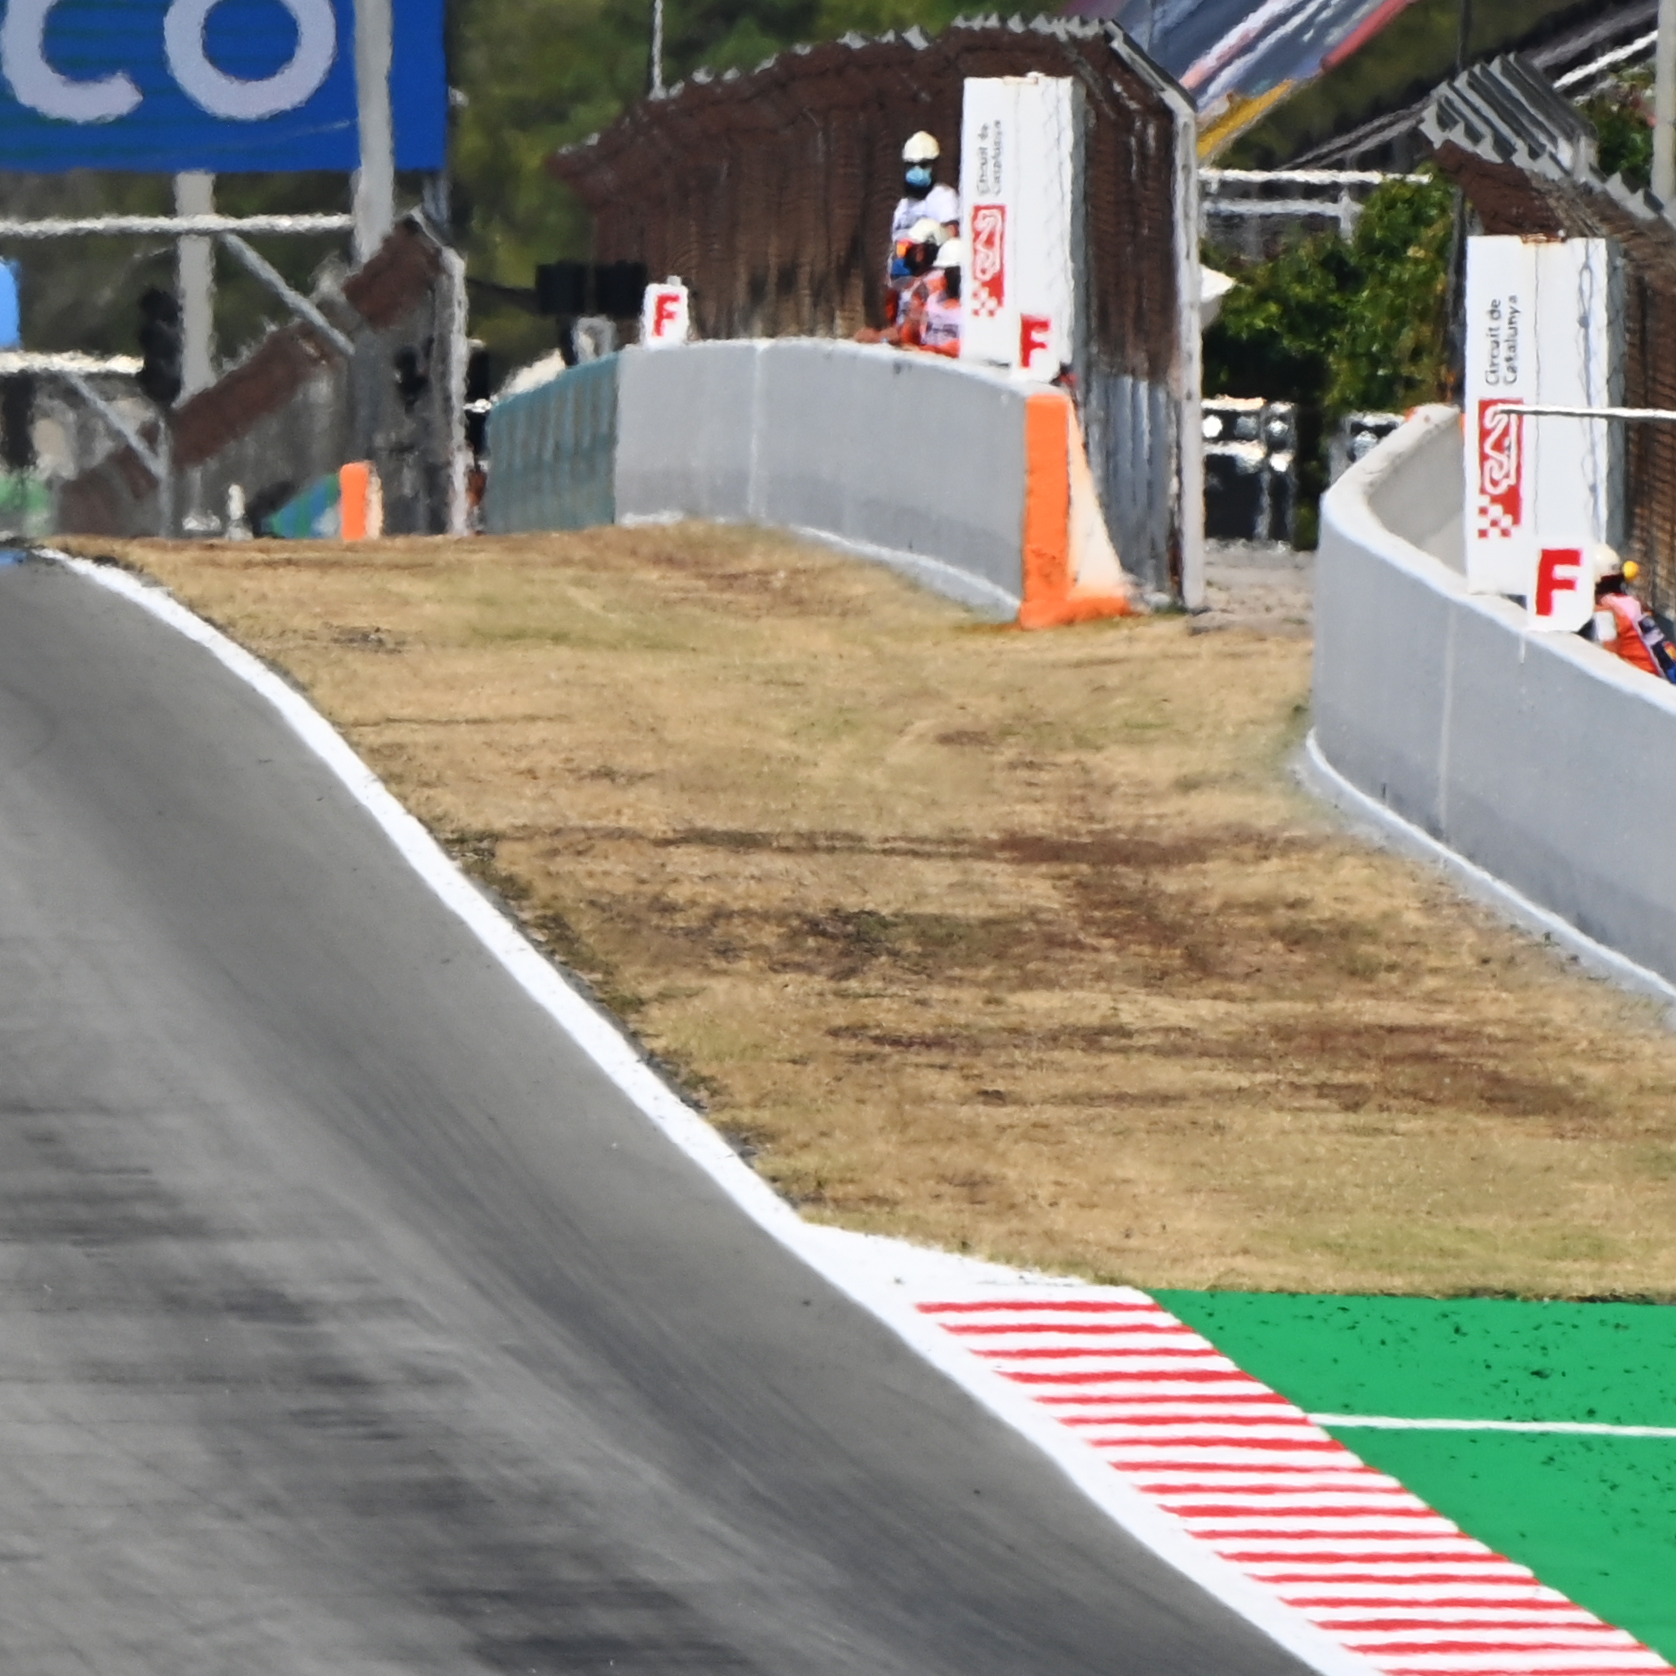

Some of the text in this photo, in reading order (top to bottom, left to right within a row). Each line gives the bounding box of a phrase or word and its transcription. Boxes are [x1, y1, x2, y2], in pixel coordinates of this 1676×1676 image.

[653, 293, 680, 337] F
[1020, 315, 1052, 370] F
[1485, 298, 1501, 385] Circuit de
[1504, 294, 1520, 385] Catalunya
[1535, 548, 1584, 617] F
